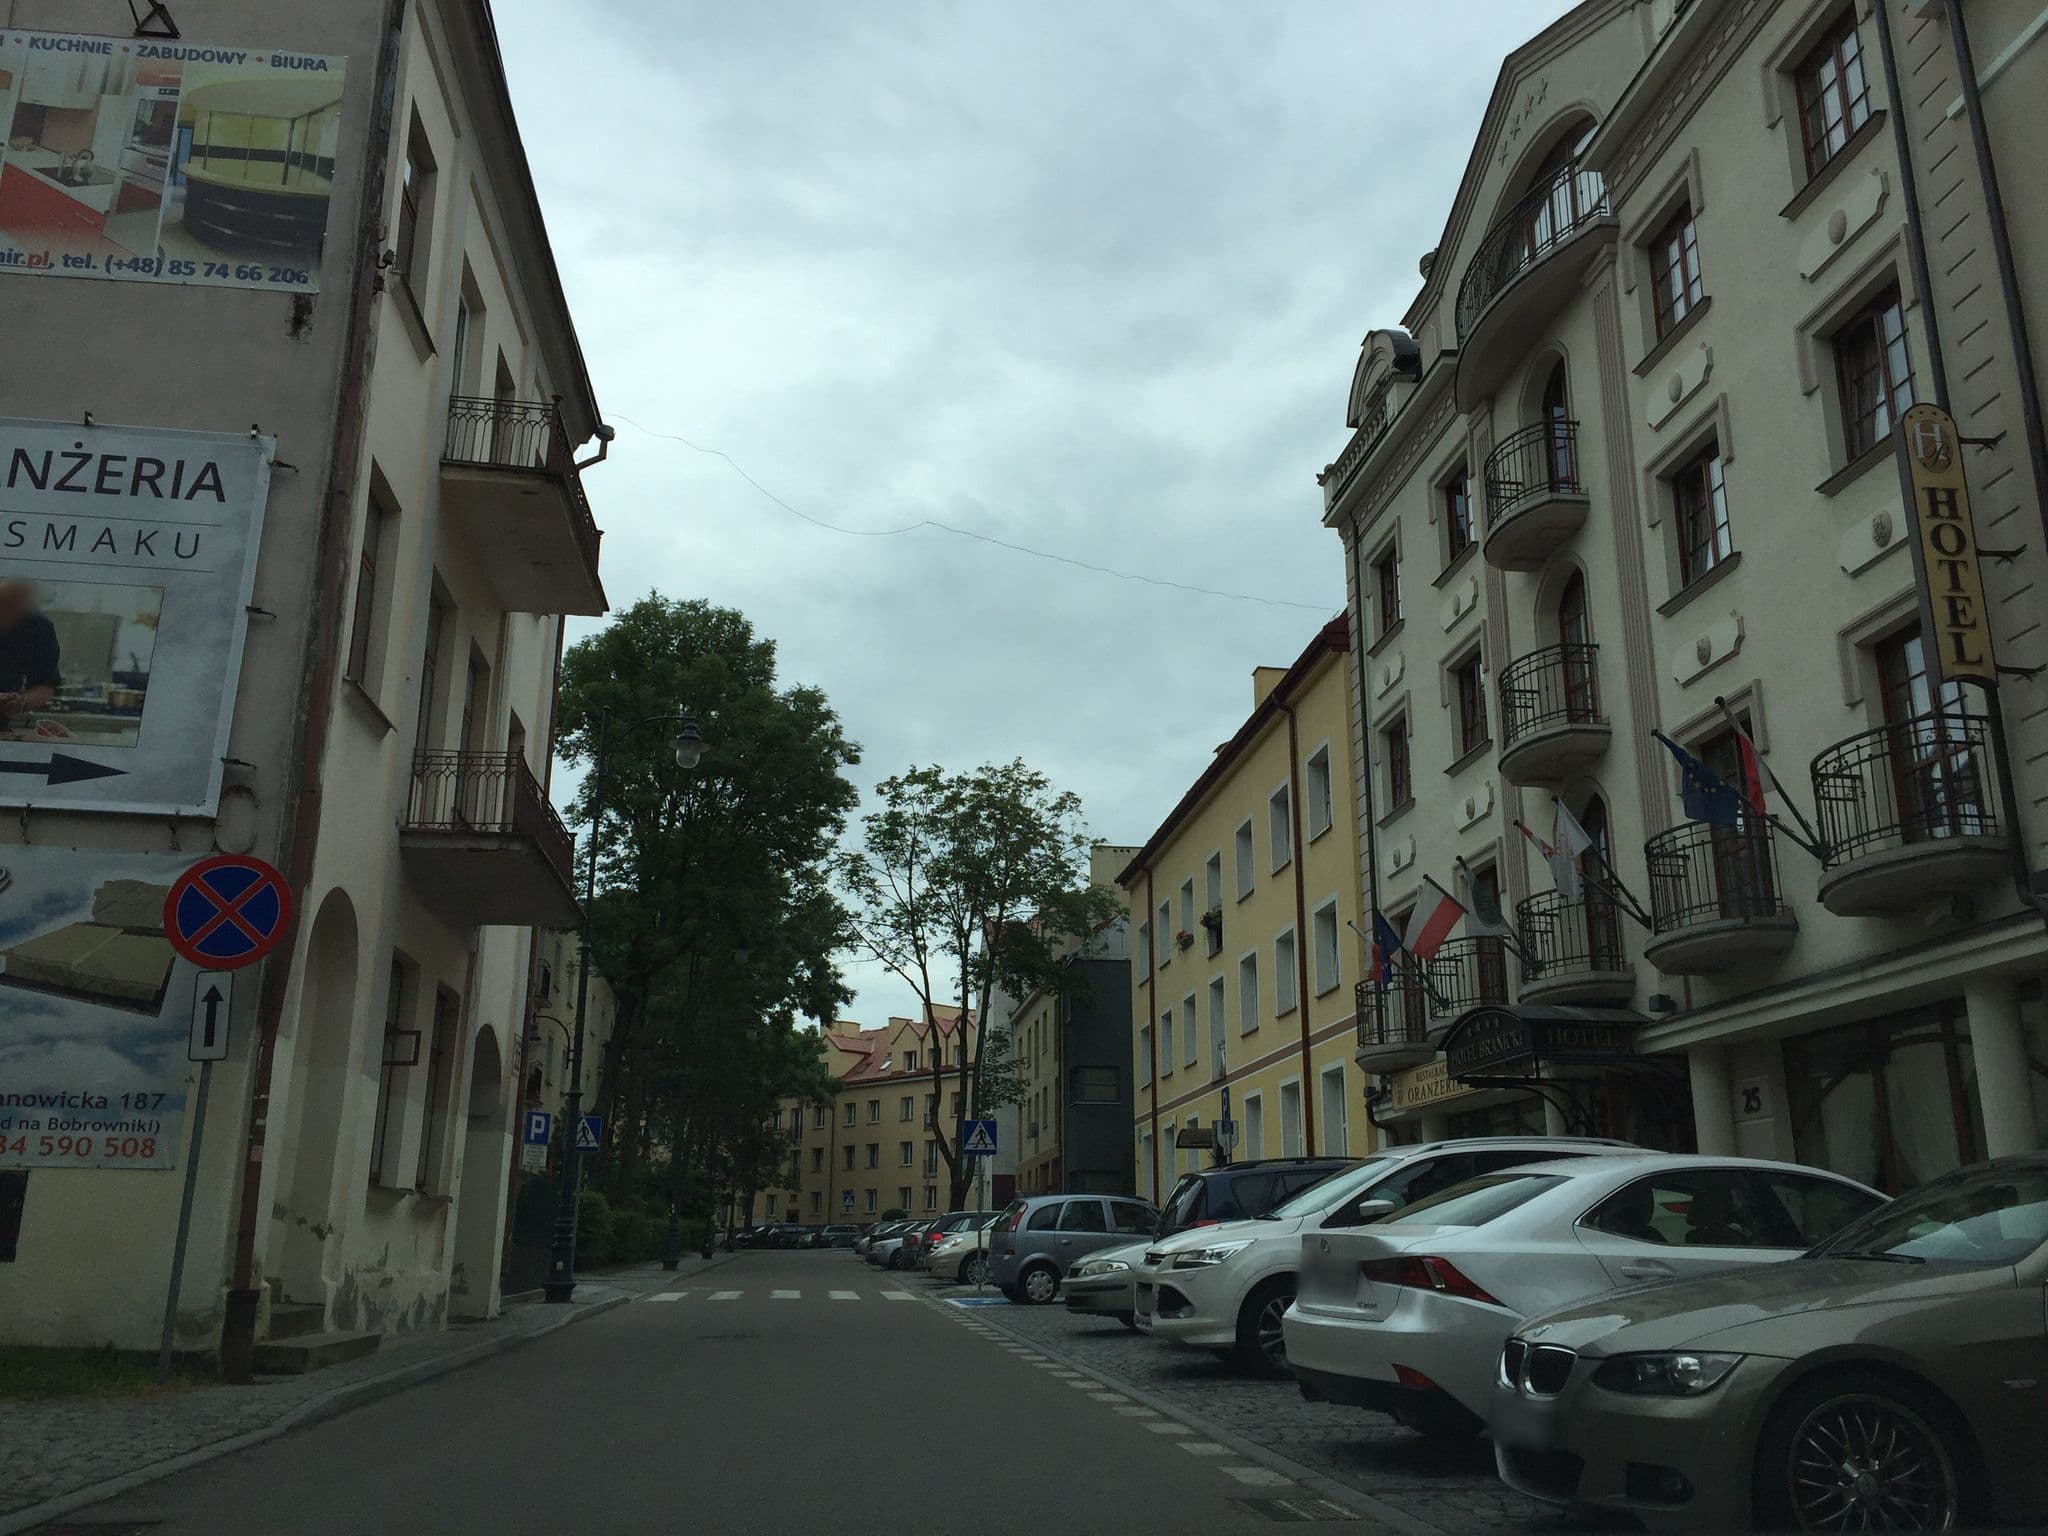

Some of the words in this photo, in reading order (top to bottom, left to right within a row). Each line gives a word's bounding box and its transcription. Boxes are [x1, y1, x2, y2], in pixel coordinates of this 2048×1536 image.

[29, 36, 113, 56] KUCHNIE
[136, 45, 248, 65] ZABUDOWY
[271, 54, 328, 72] BIURA
[62, 252, 97, 269] tel.
[105, 253, 163, 277] (+48)
[168, 260, 195, 276] 85
[203, 262, 229, 278] 74
[235, 264, 263, 281] 66
[268, 267, 309, 285] 206
[0, 442, 226, 503] NŻERIA
[4, 520, 200, 560] SMAKU
[1921, 487, 1983, 666] HOTEL
[121, 1093, 167, 1111] 187
[18, 1119, 40, 1130] na
[48, 1117, 161, 1135] Bobrowniki)
[530, 1114, 546, 1141] P
[38, 1136, 93, 1157] 590
[104, 1137, 157, 1159] 508
